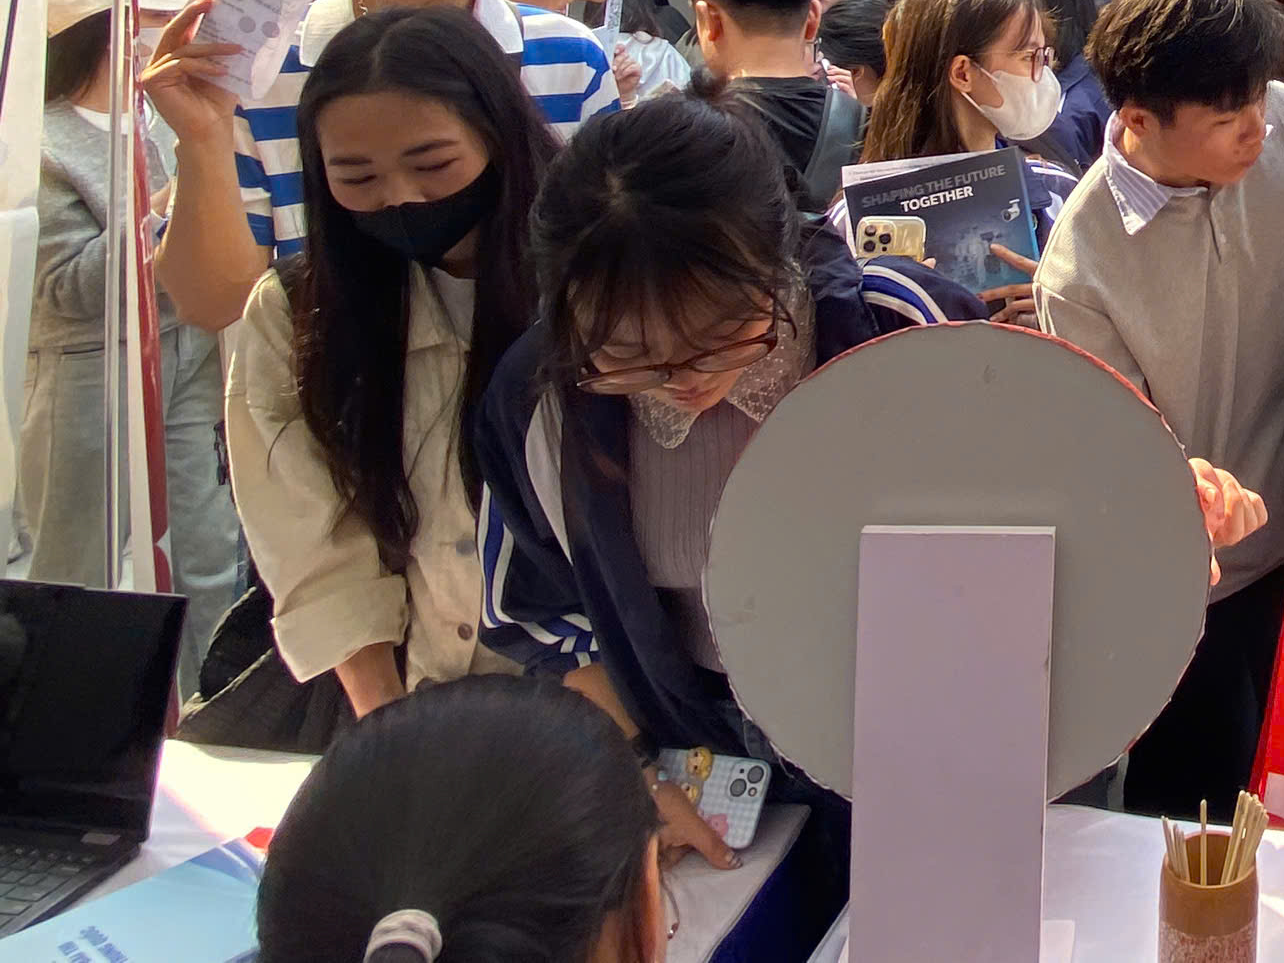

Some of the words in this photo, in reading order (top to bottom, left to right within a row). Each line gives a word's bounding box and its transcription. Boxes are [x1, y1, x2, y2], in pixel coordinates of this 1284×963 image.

[861, 183, 925, 208] SHAPING
[926, 176, 953, 191] THE
[954, 164, 1007, 186] FUTURE
[900, 186, 974, 213] TOGETHER
